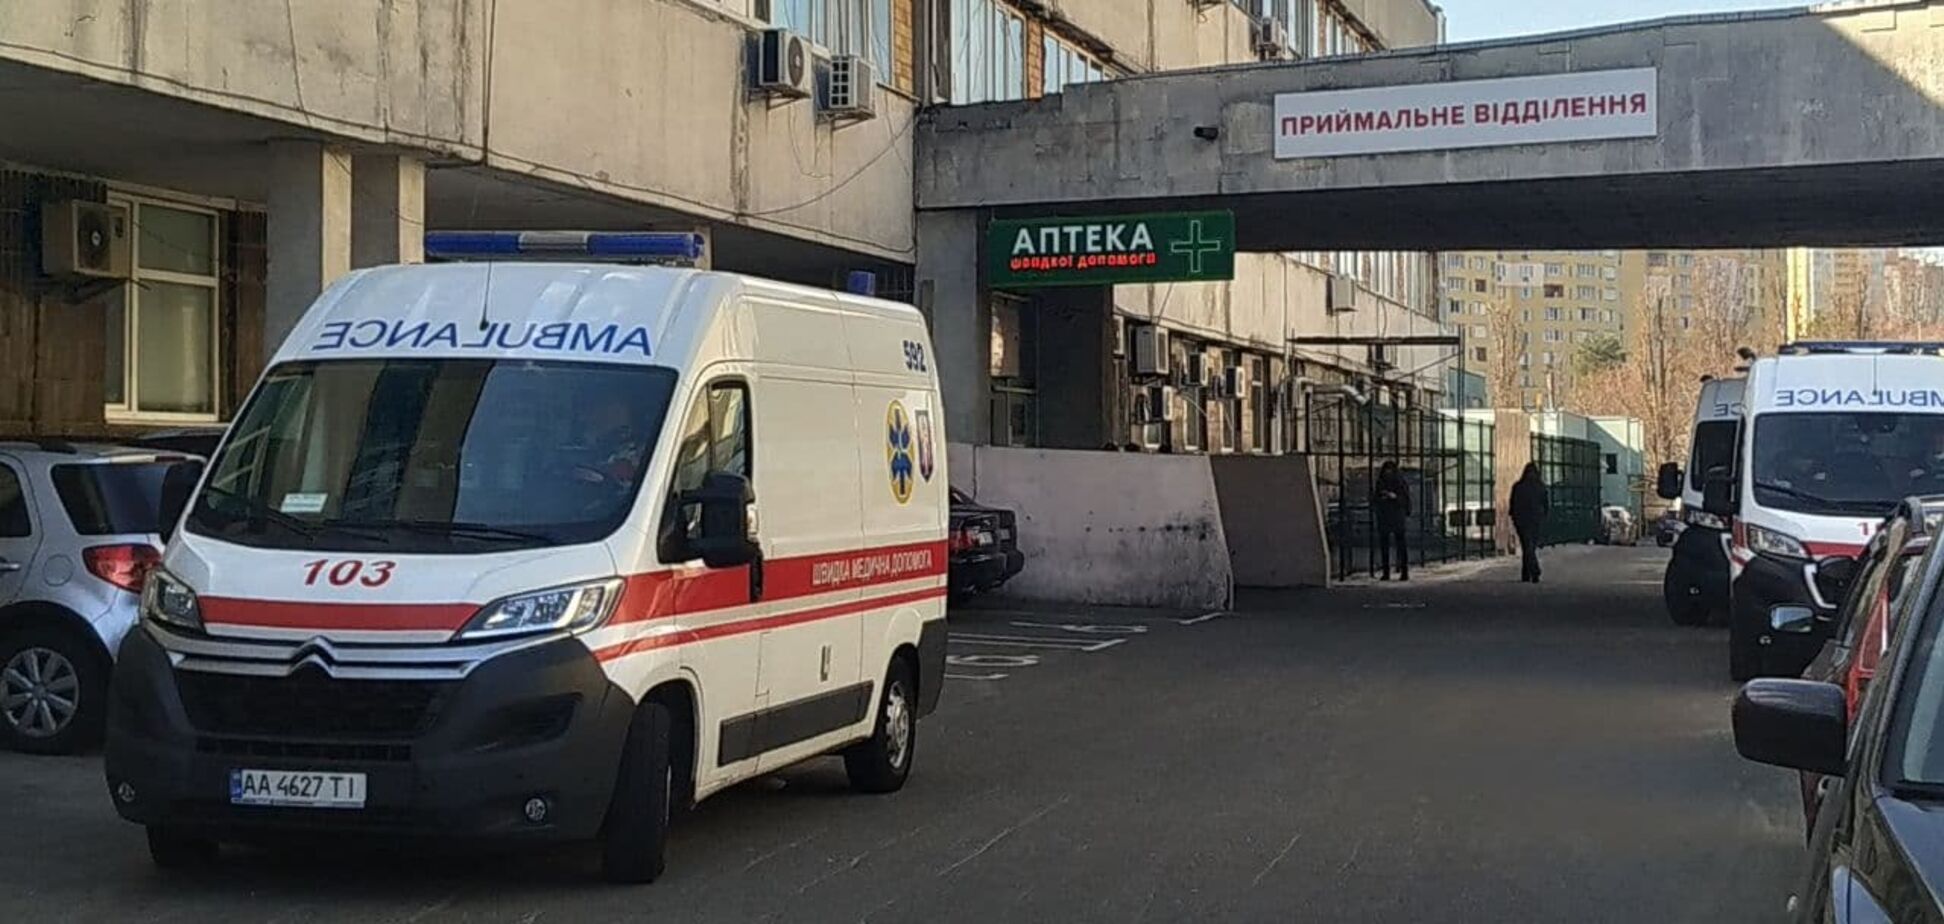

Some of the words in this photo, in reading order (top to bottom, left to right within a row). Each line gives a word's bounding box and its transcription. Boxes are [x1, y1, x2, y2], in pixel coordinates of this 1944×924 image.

[1281, 105, 1465, 136] ПРИЙМАЛЬНЕ
[1475, 92, 1646, 124] ВІДДІЛЕННЯ
[1012, 223, 1154, 254] АПТЕКА
[1010, 255, 1073, 270] швидкої
[1077, 252, 1156, 269] допомоги
[903, 340, 926, 372] 592
[304, 559, 396, 587] 103
[812, 560, 850, 587] ШВИДКА
[852, 554, 890, 581] МЕДИЧНА
[891, 550, 932, 577] ДОПОМОГА
[243, 773, 271, 796] AA
[277, 775, 323, 798] 4627
